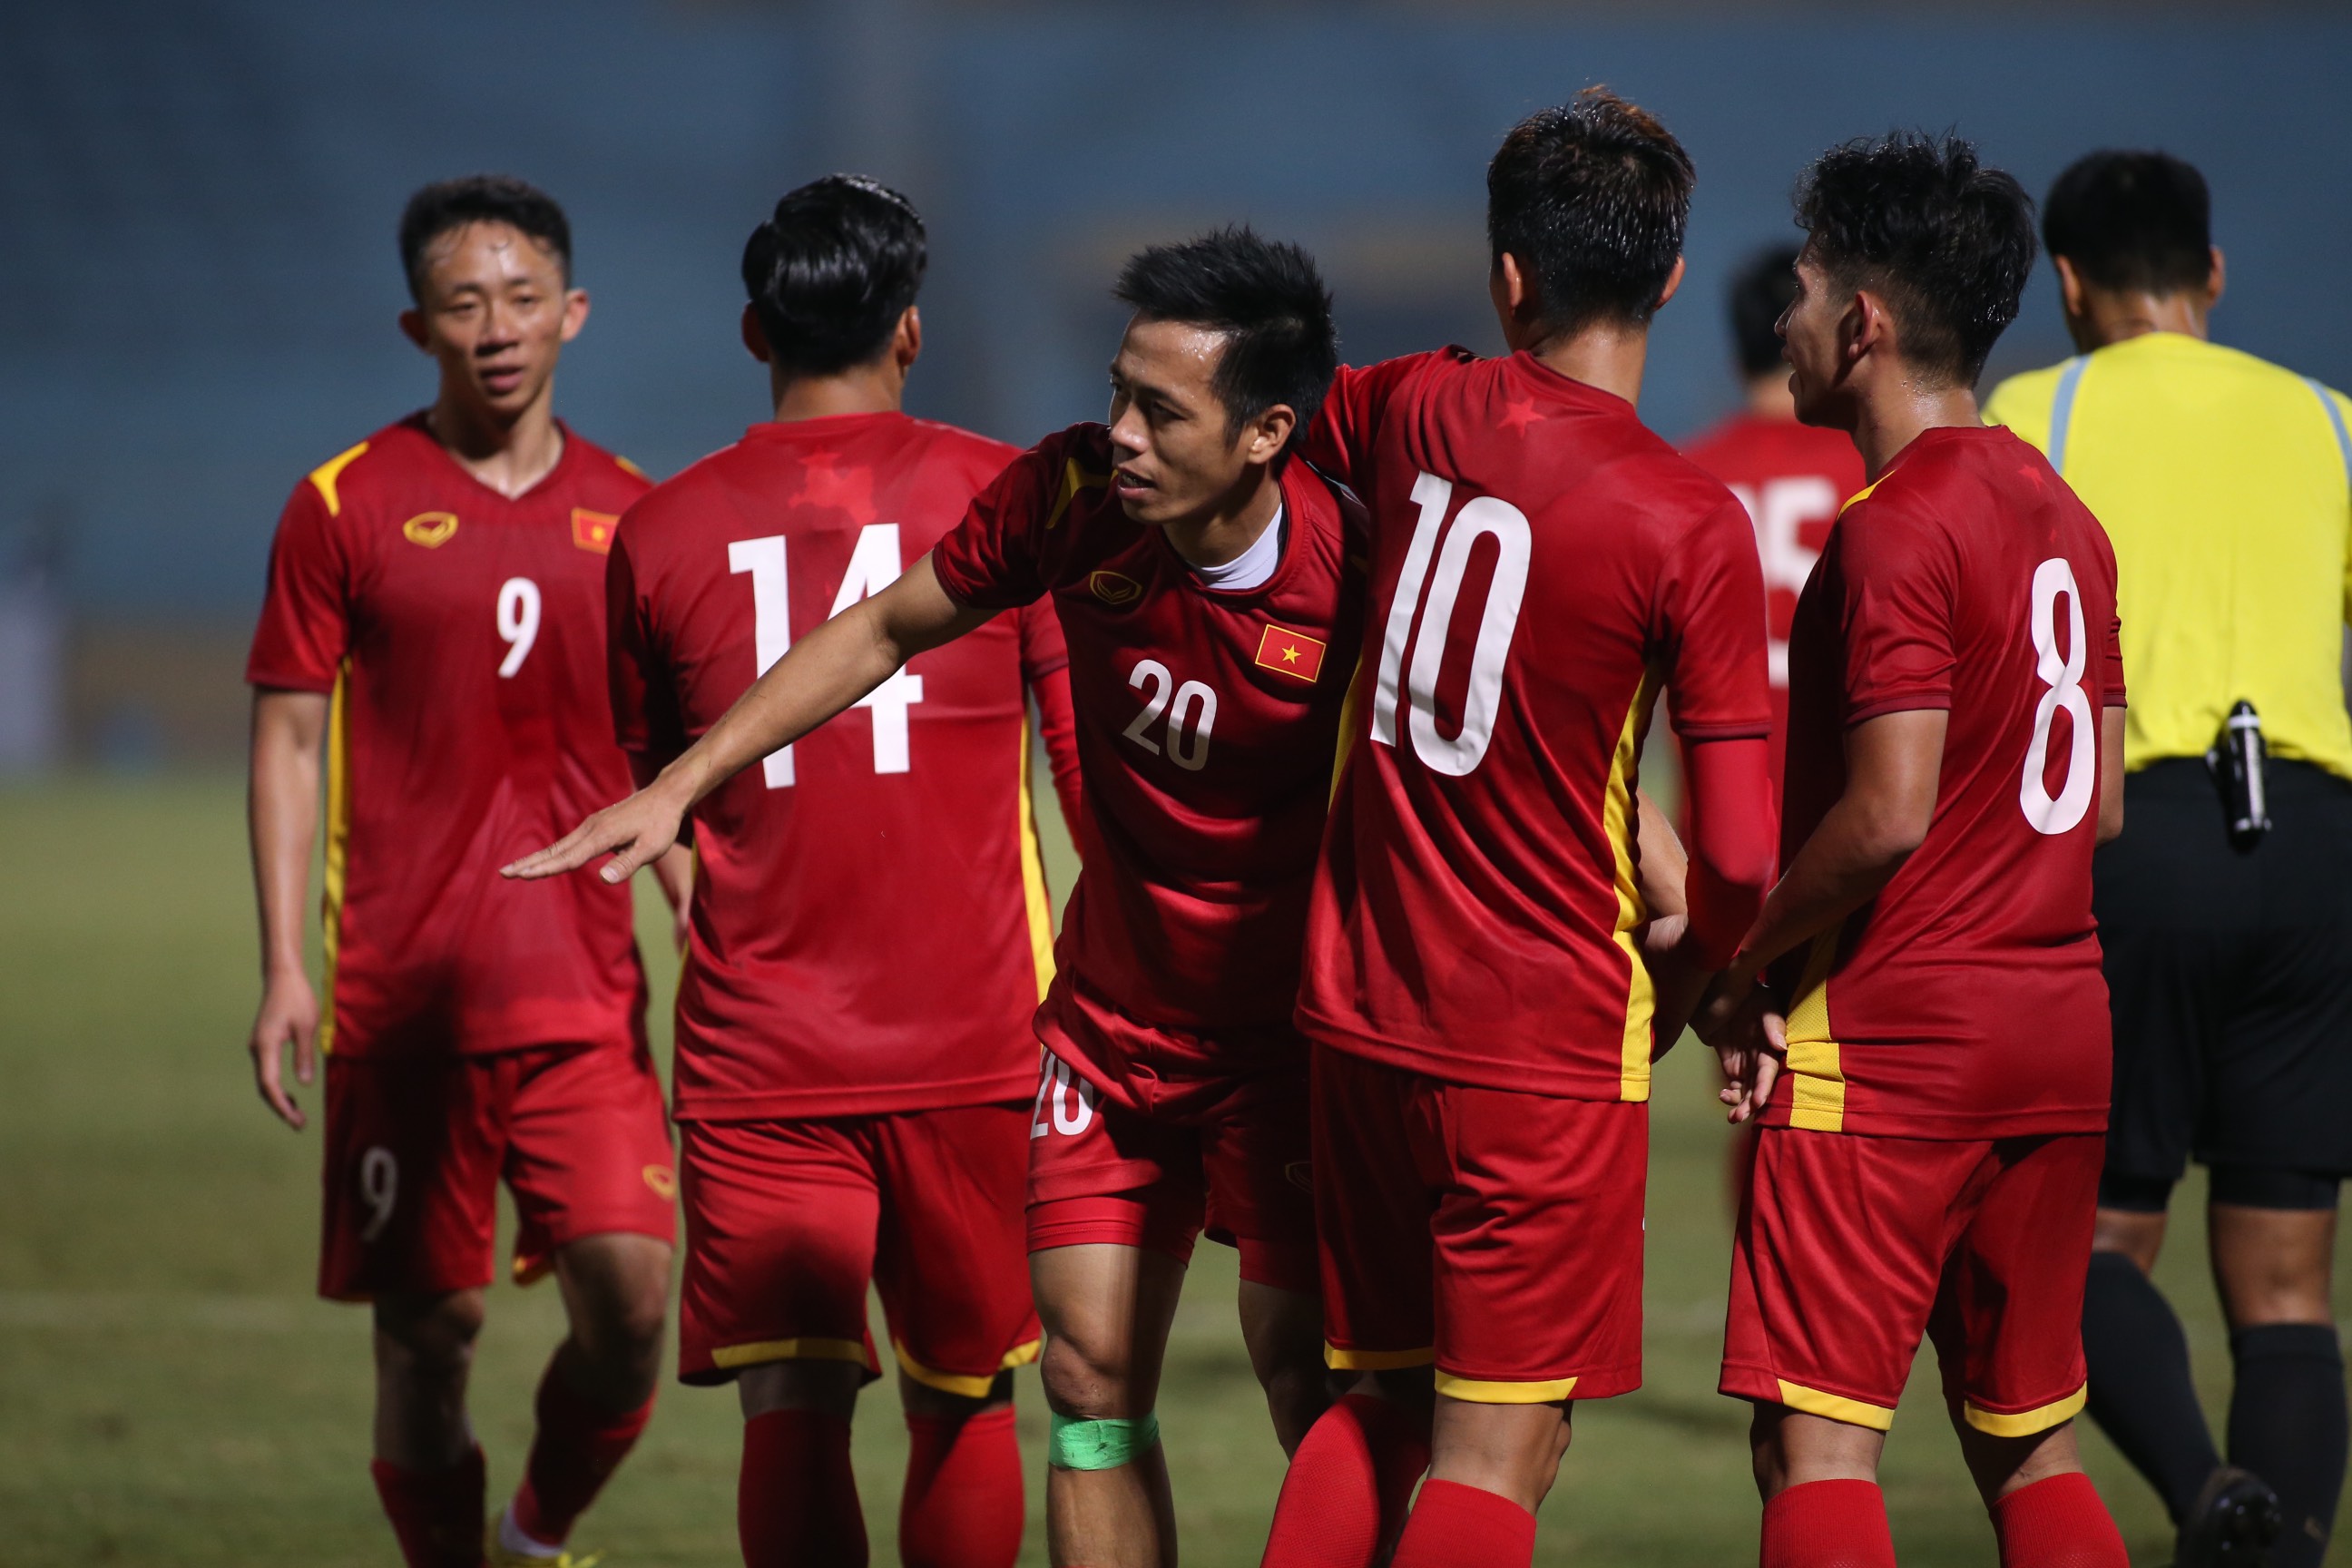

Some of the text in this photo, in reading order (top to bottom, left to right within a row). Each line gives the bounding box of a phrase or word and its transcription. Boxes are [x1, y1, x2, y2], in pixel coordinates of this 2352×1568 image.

[496, 576, 542, 678] 9
[728, 523, 924, 789] 14
[1370, 470, 1533, 777] 10
[1725, 473, 1838, 688] 5
[1122, 659, 1218, 771] 20
[2020, 557, 2095, 835] 8
[1030, 1044, 1093, 1141] 20
[362, 1145, 397, 1242] 9
